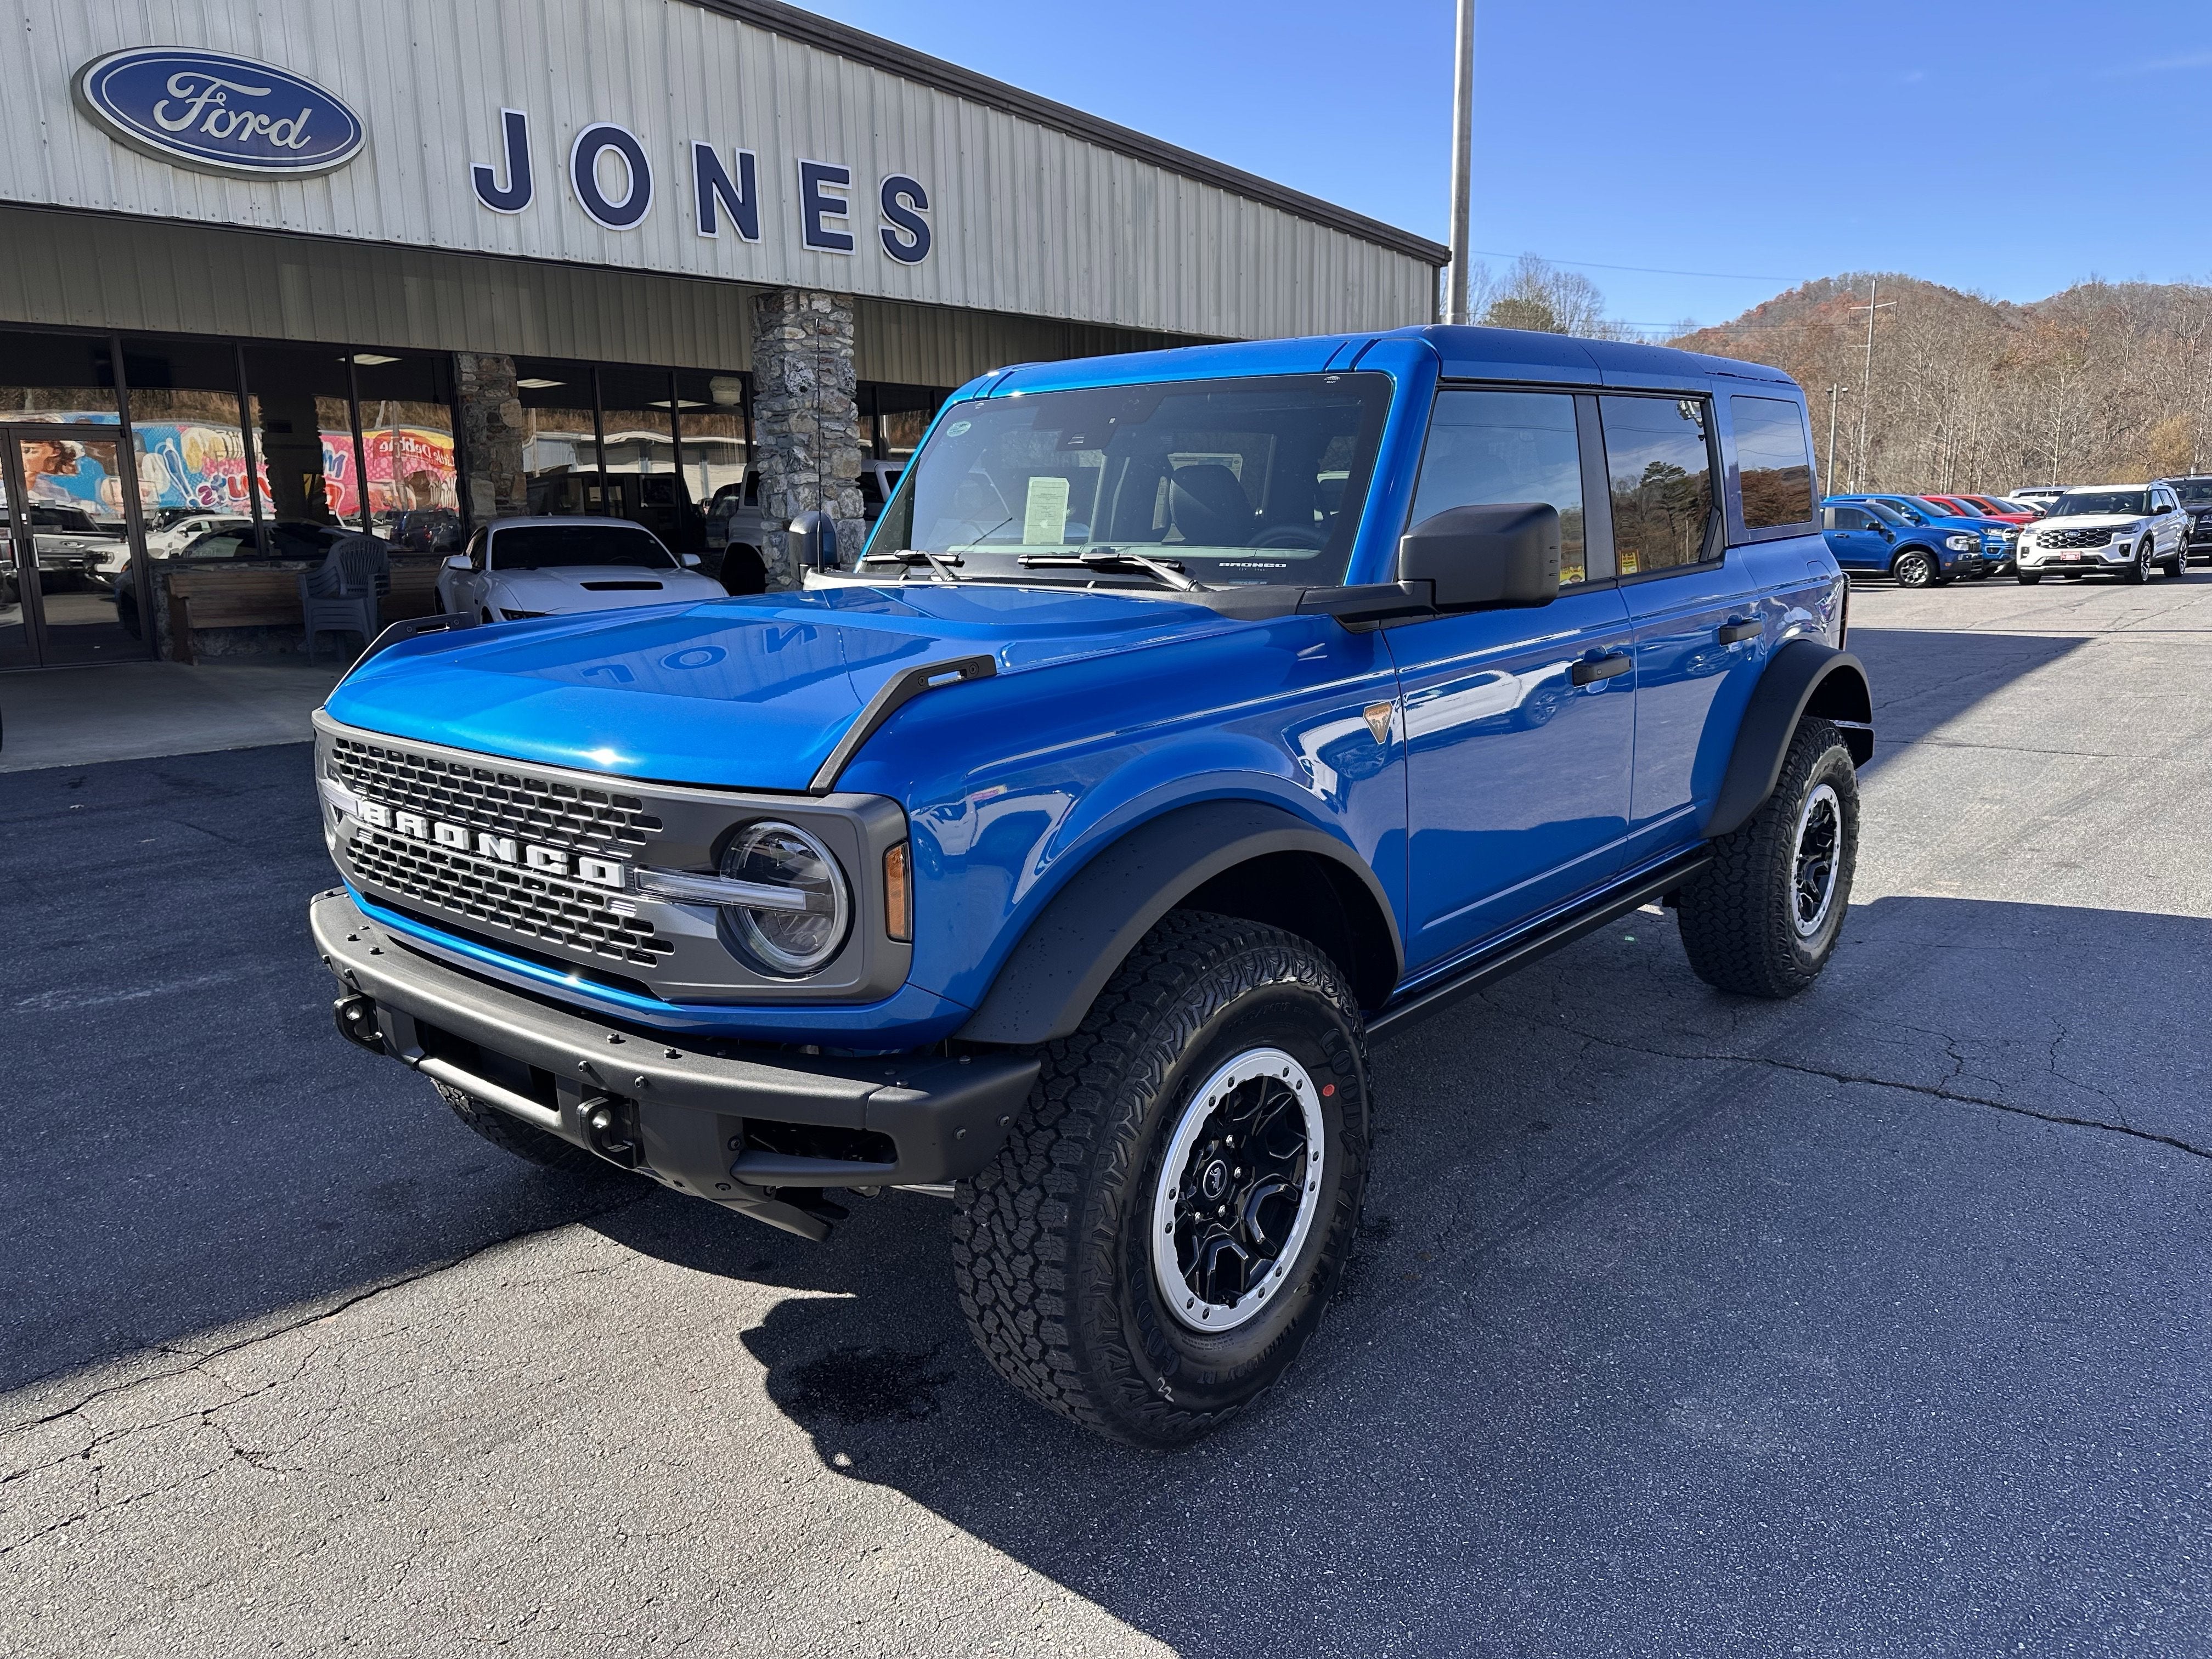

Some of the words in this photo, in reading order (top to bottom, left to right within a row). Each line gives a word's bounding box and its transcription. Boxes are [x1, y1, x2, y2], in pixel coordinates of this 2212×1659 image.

[153, 72, 312, 150] Ford
[470, 108, 932, 266] JONES
[362, 800, 625, 888] BRONCO
